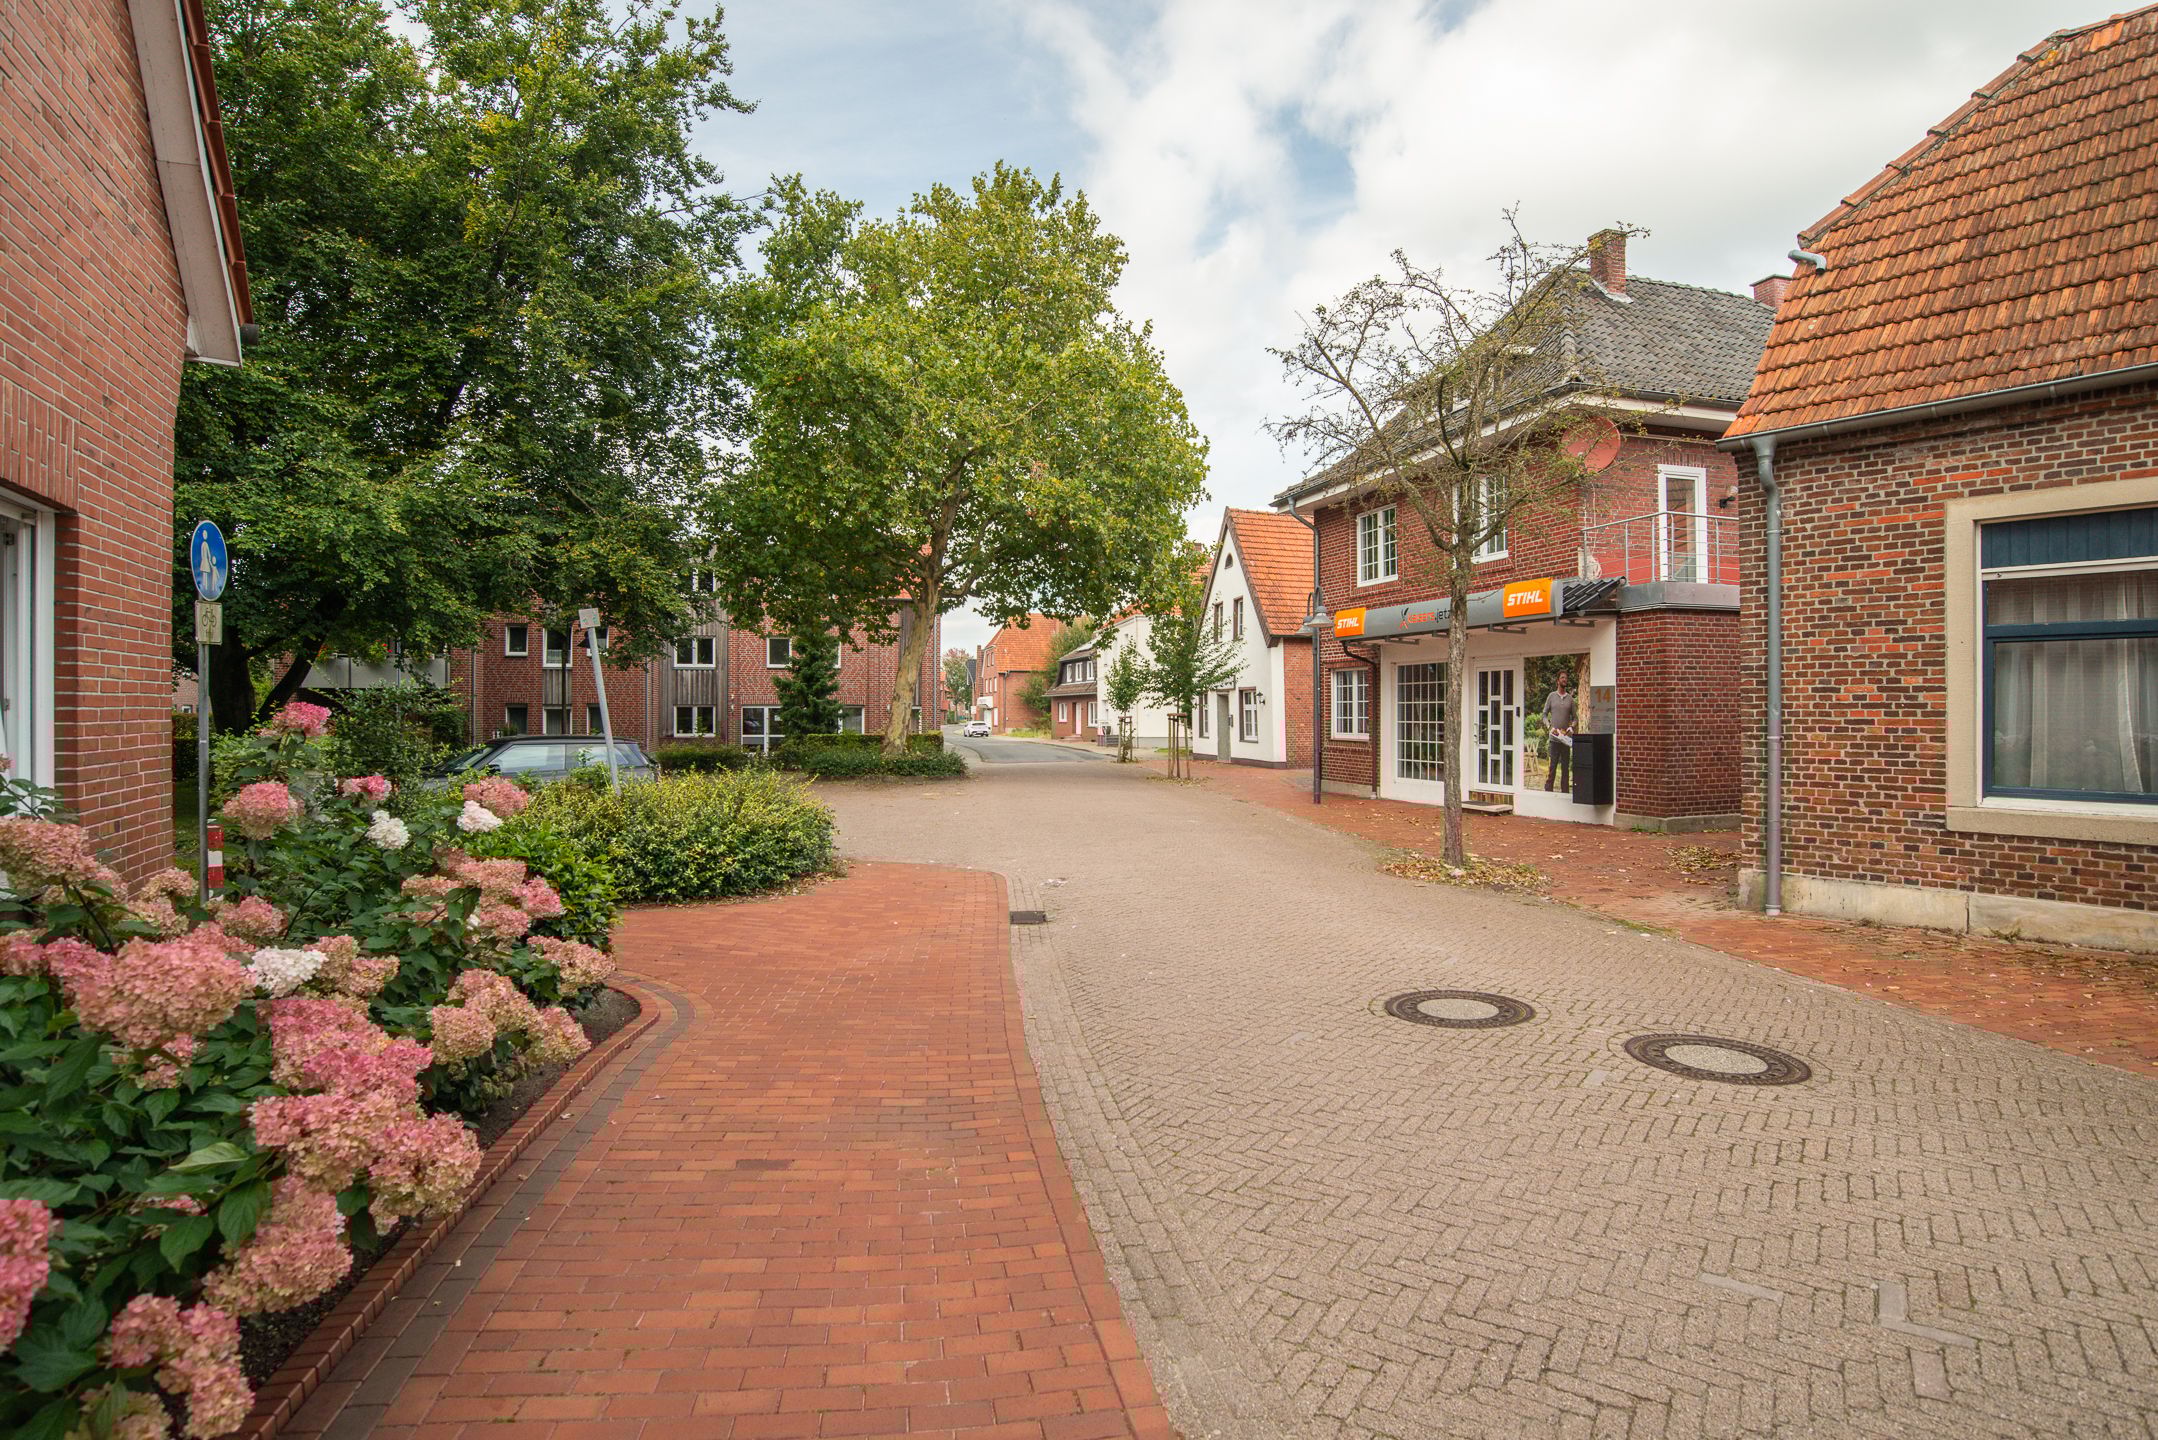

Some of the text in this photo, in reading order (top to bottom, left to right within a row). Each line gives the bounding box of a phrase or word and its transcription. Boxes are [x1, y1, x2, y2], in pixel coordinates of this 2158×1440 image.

[1507, 590, 1543, 606] STIHL
[1337, 617, 1360, 629] STIHL
[1595, 688, 1612, 703] 14
